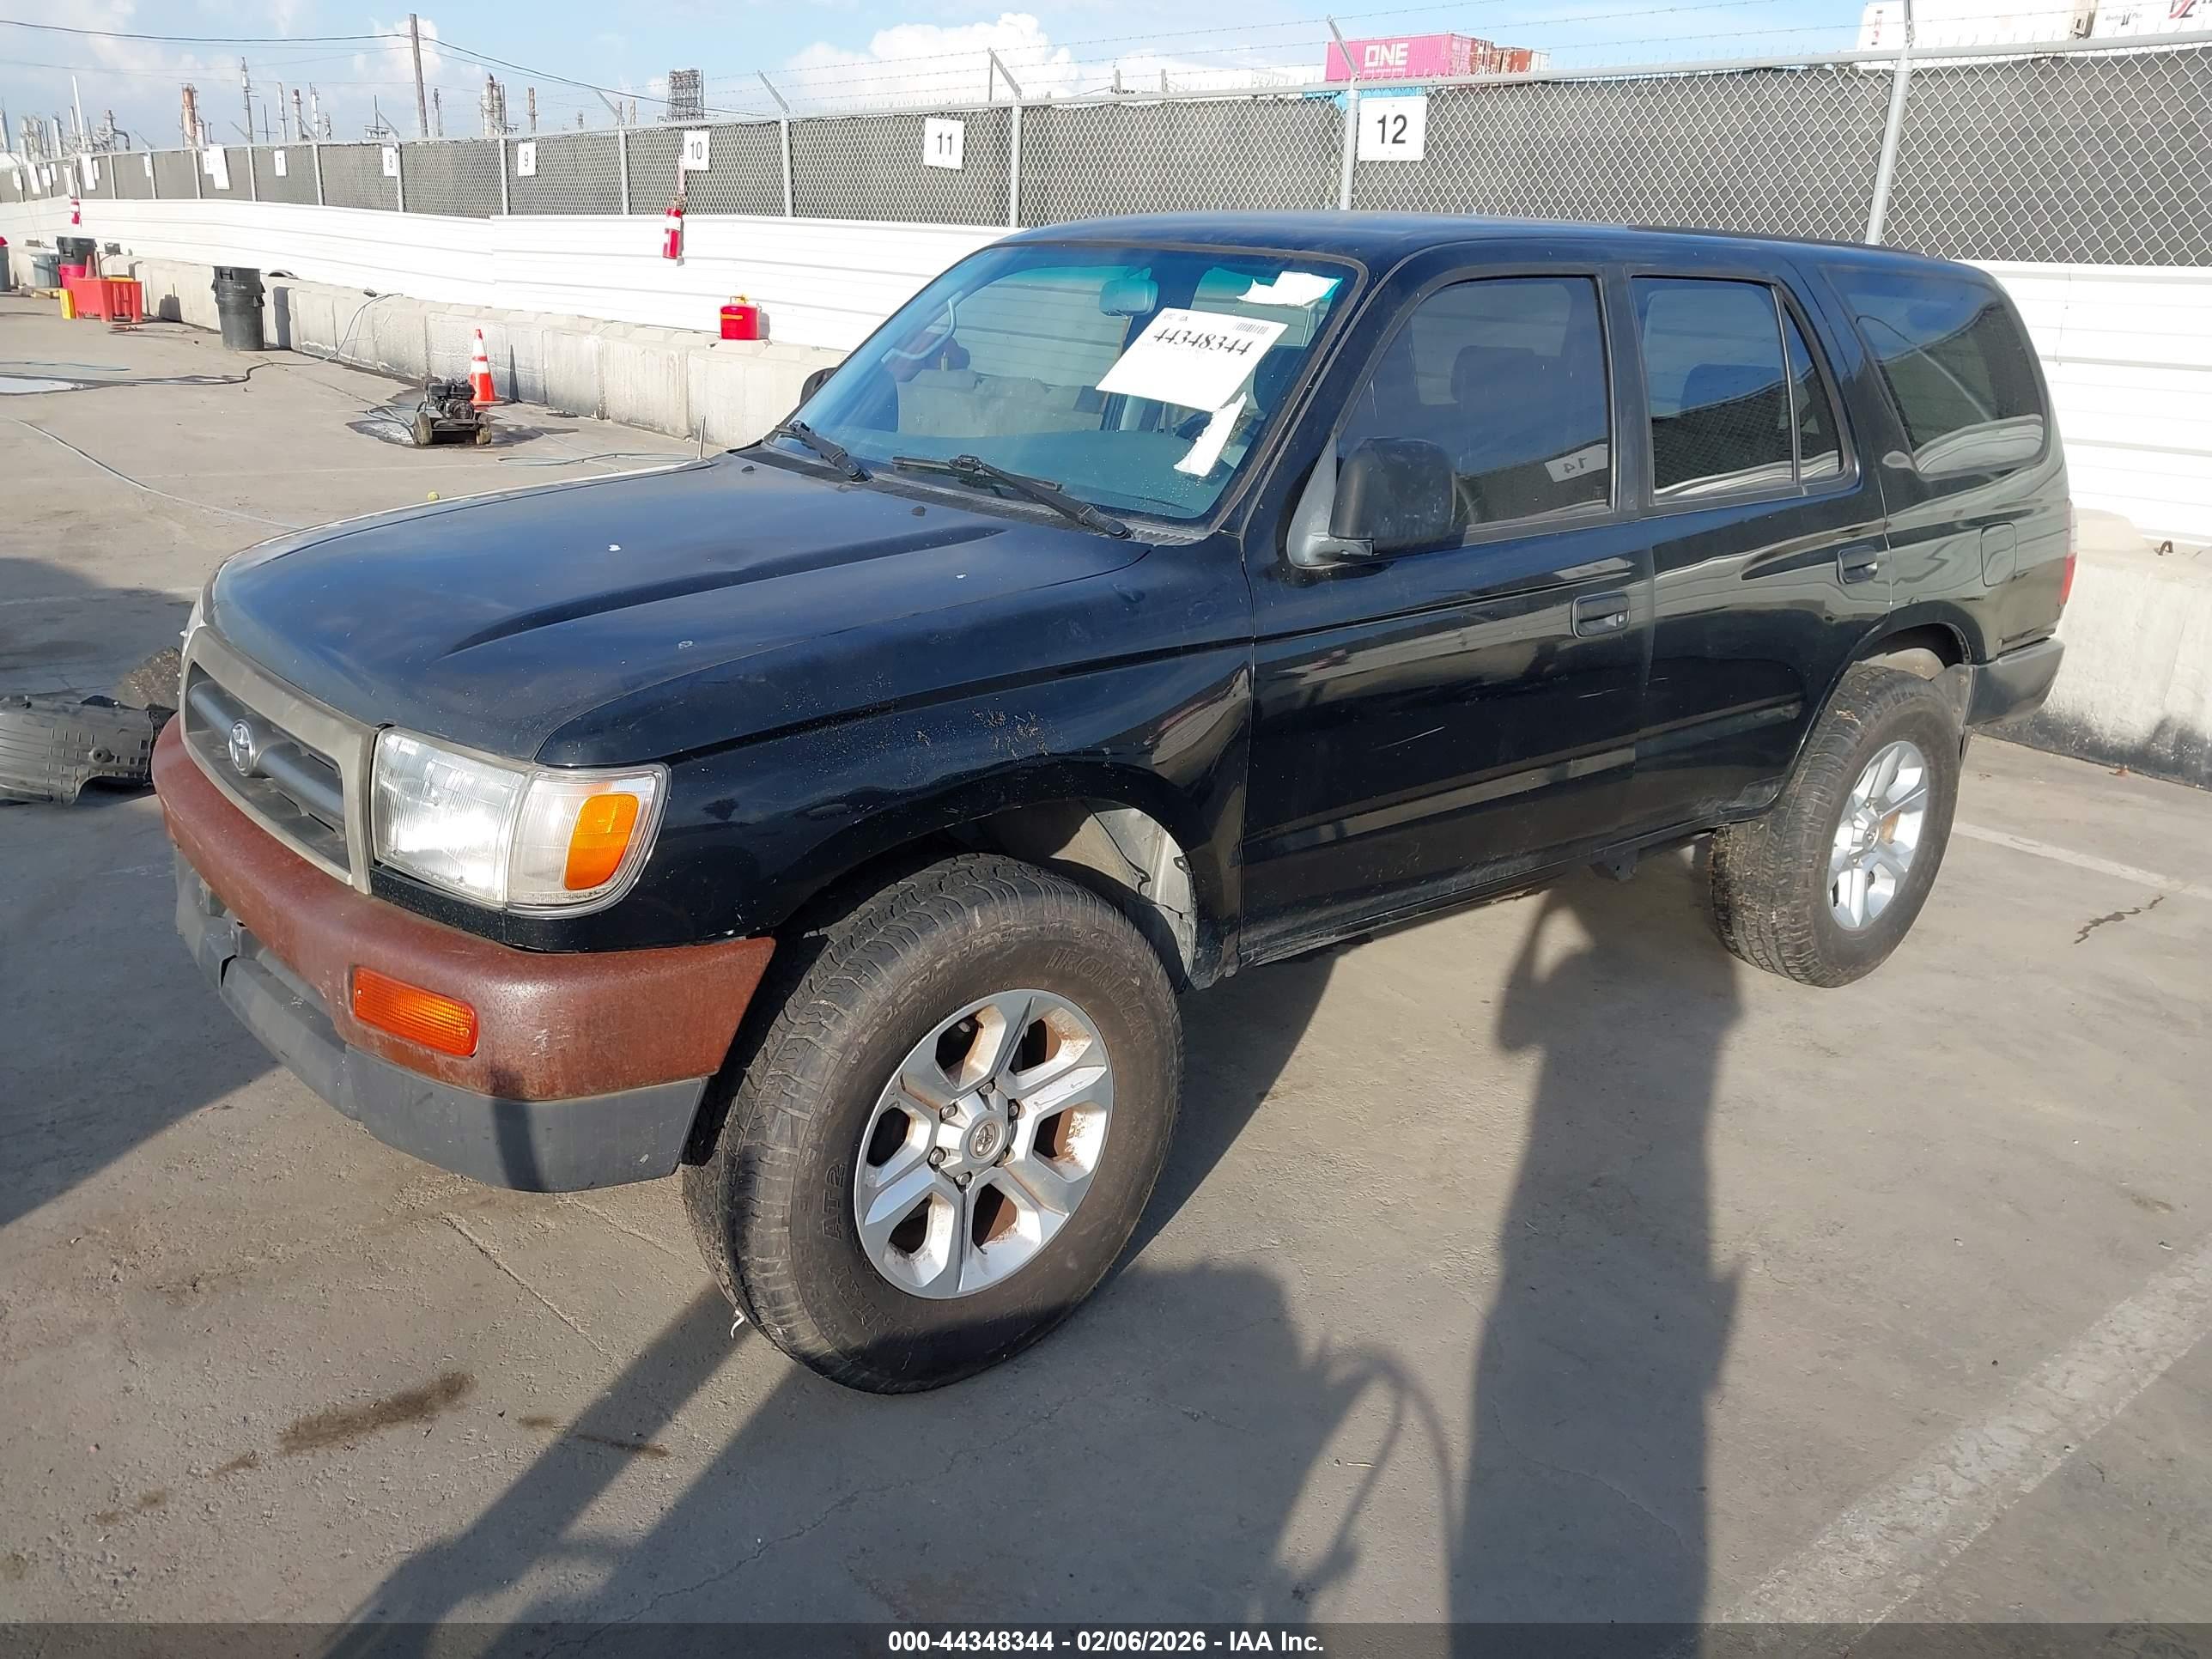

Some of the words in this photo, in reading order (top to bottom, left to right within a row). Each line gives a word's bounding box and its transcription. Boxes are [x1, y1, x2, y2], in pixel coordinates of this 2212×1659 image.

[1364, 42, 1409, 68] ONE
[1377, 113, 1407, 144] 12
[690, 140, 703, 161] 10
[937, 131, 953, 155] 11
[523, 150, 530, 167] 9
[1153, 327, 1255, 356] 44348344
